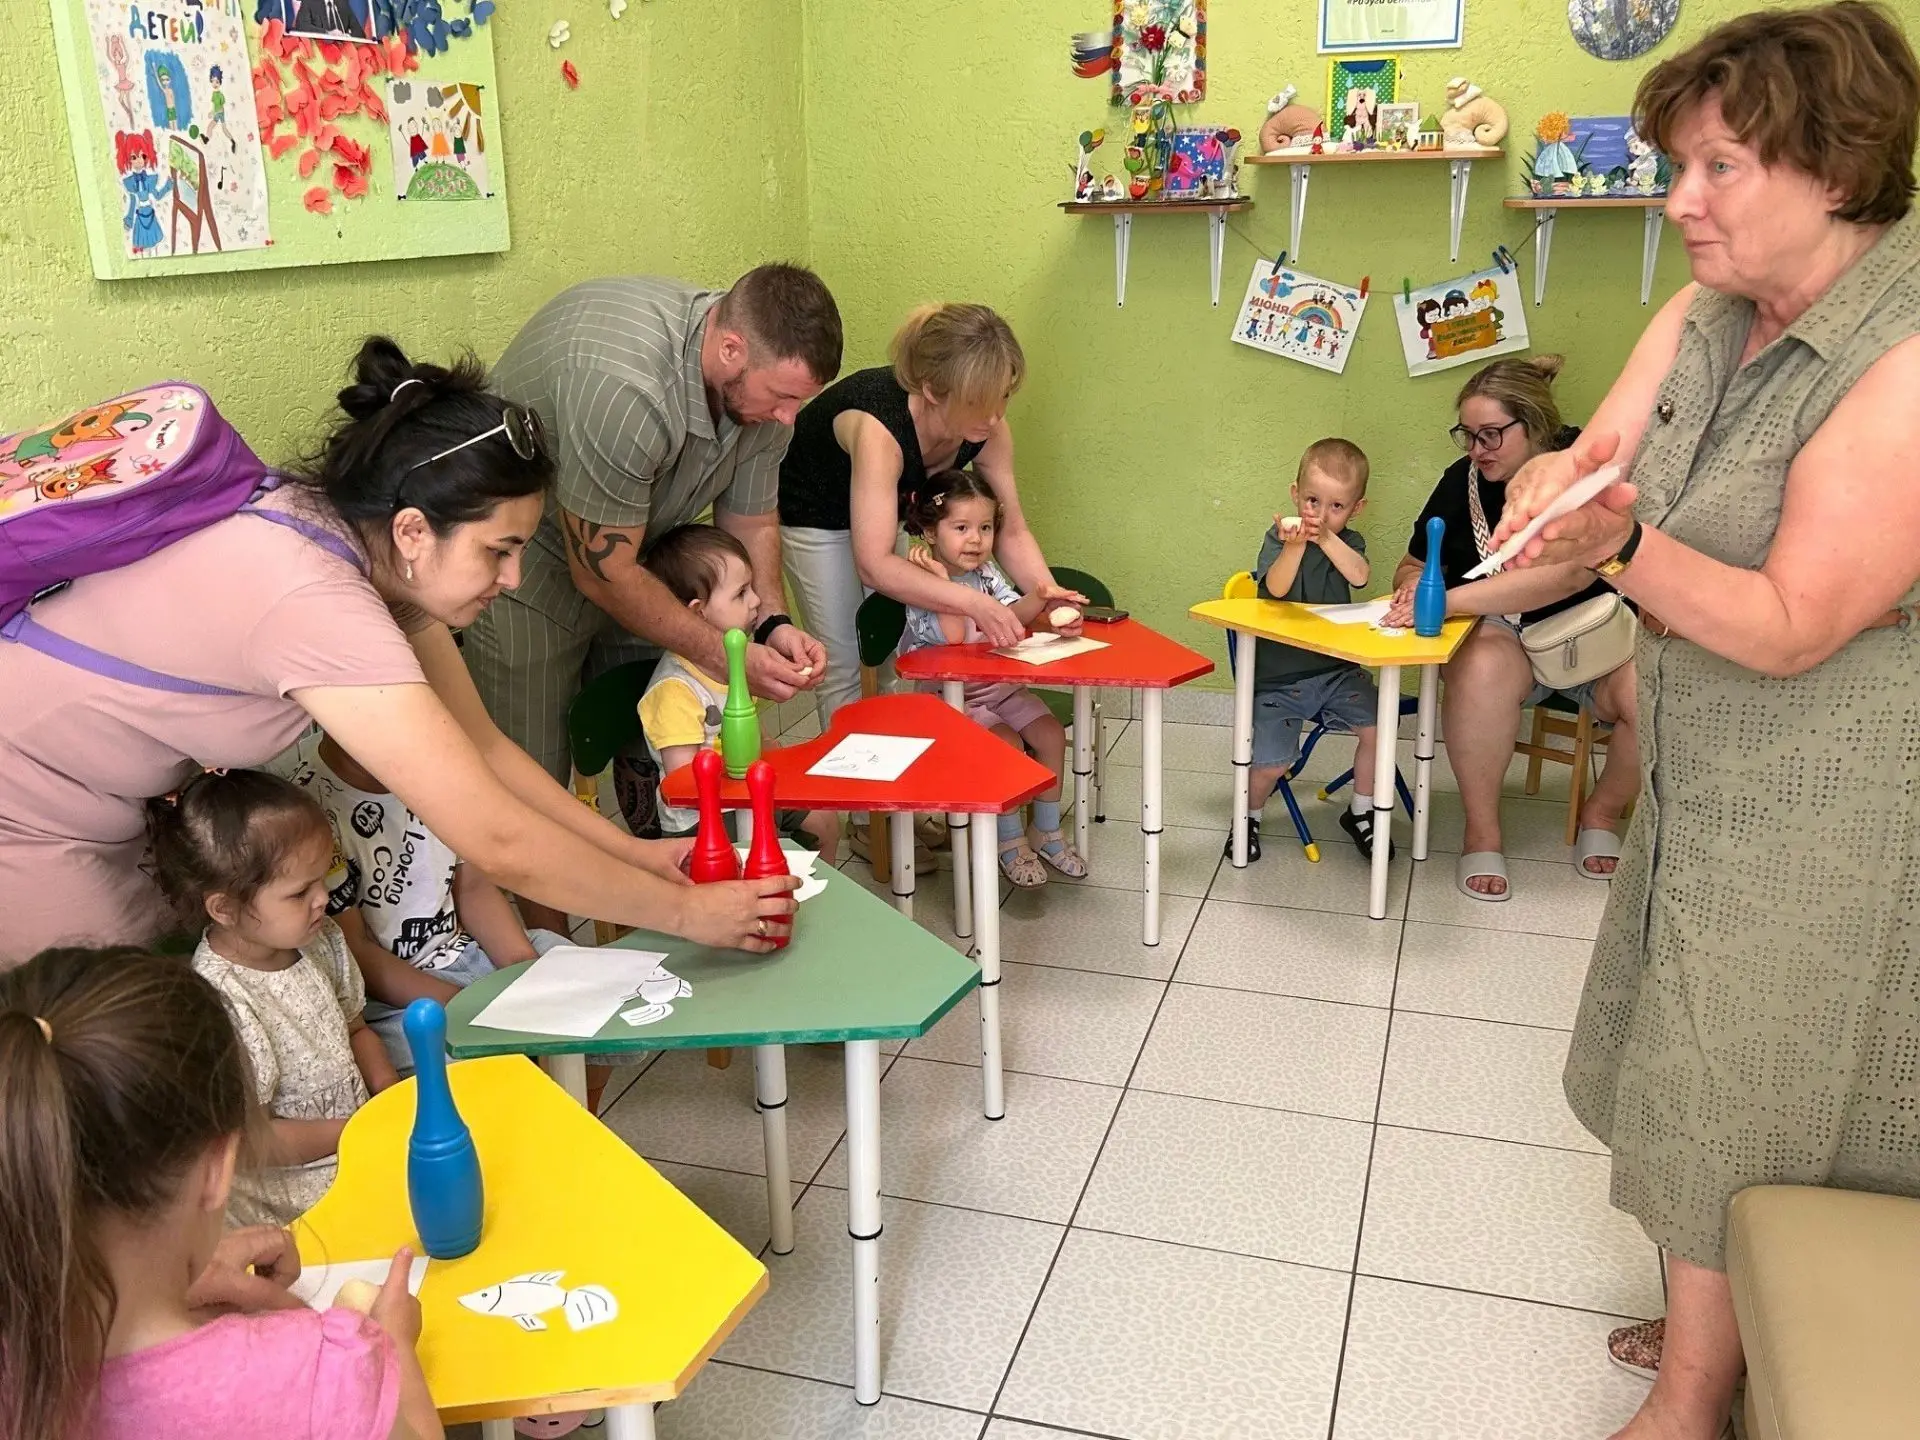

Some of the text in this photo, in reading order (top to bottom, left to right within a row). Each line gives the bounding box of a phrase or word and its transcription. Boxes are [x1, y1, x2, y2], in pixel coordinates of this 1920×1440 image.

[1249, 296, 1290, 315] ИЮНЯ
[358, 804, 377, 827] OK
[384, 830, 425, 905] Looking
